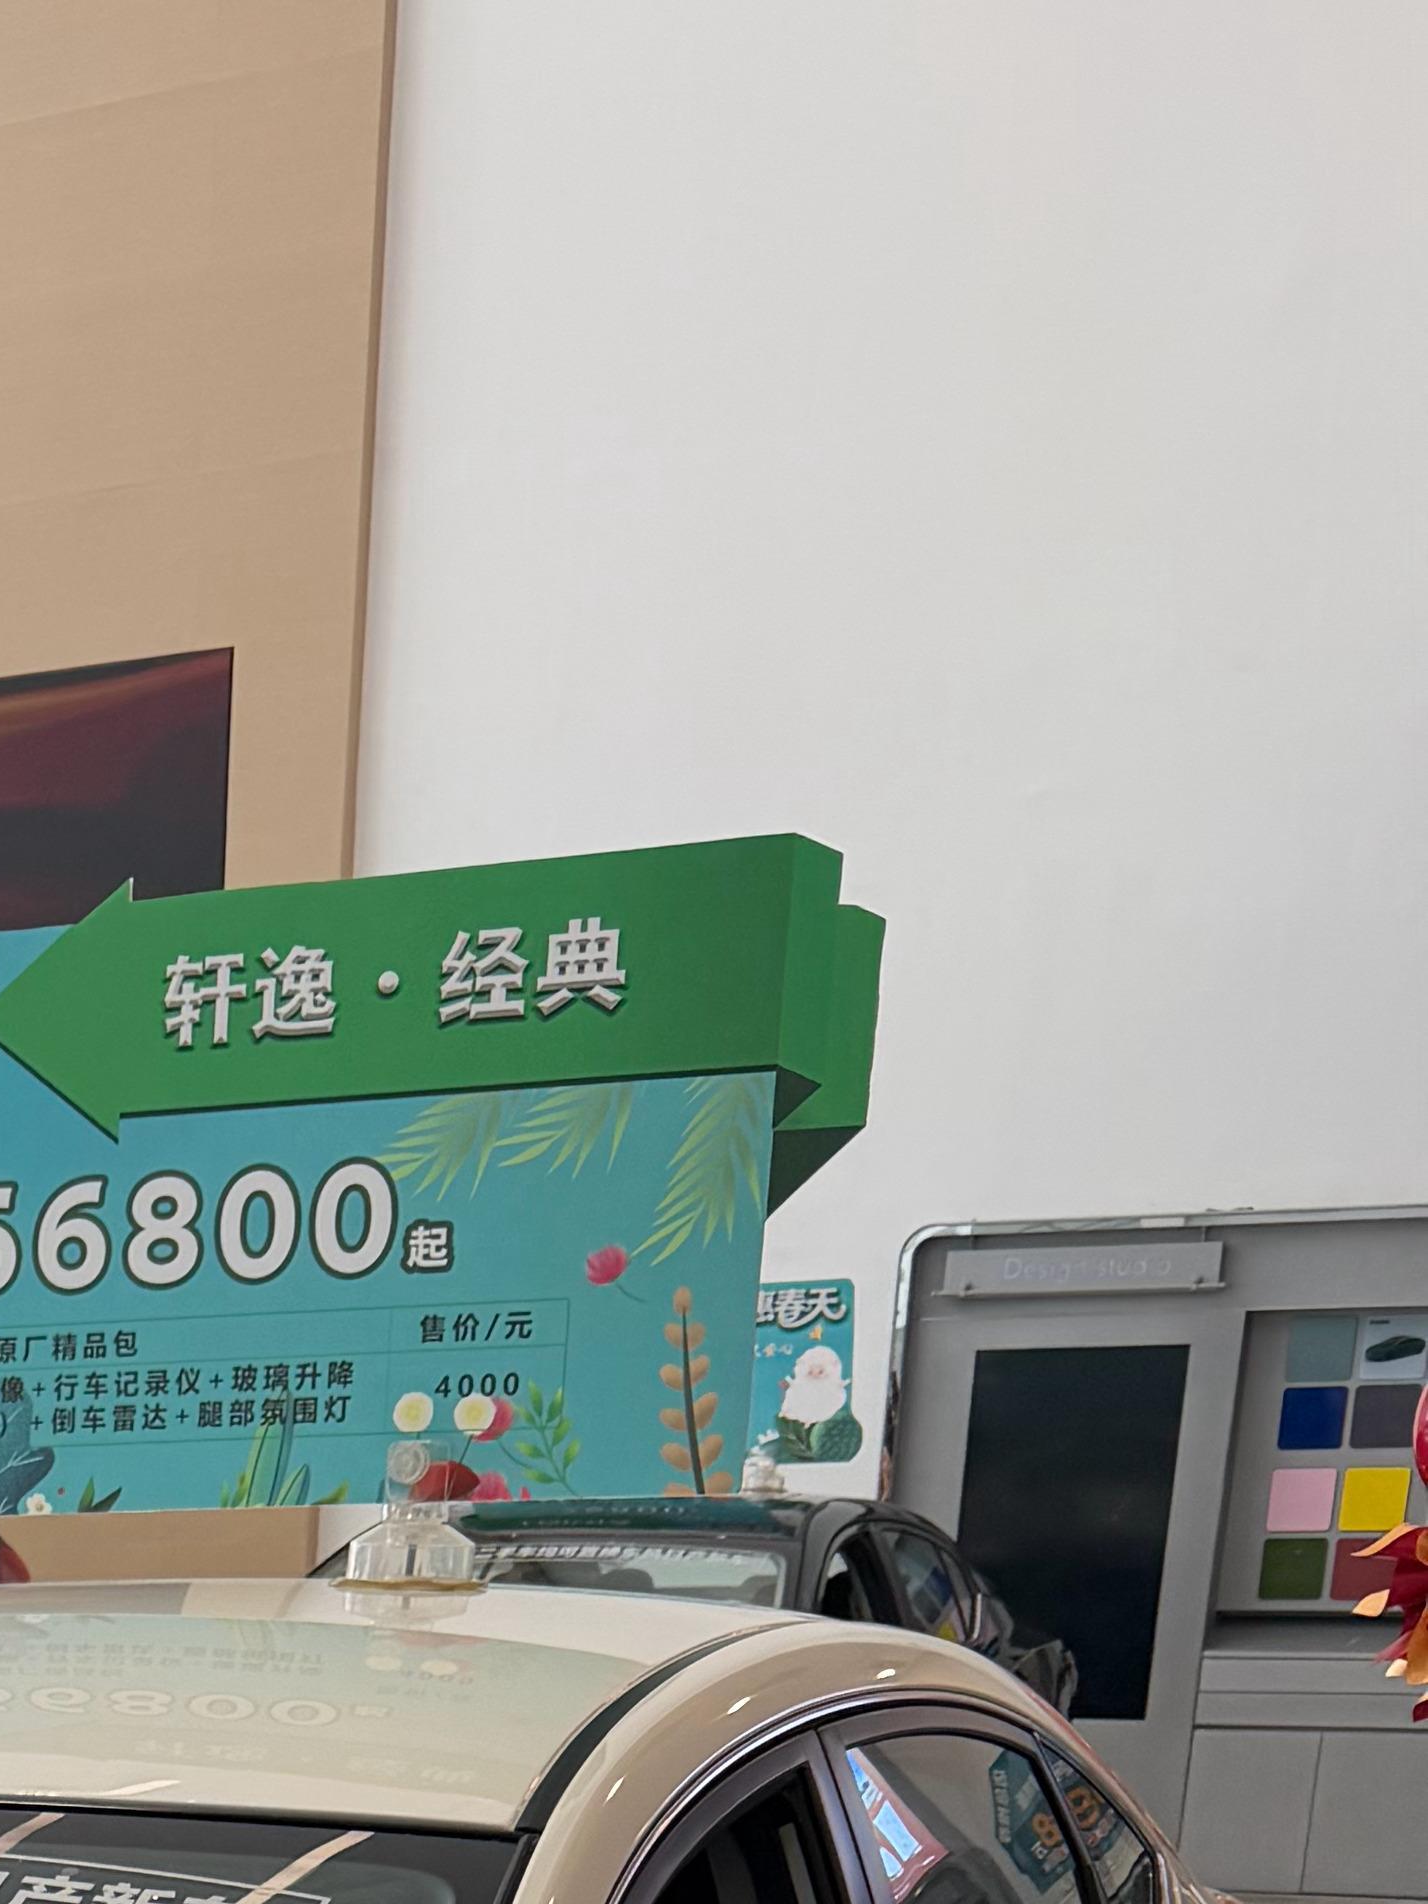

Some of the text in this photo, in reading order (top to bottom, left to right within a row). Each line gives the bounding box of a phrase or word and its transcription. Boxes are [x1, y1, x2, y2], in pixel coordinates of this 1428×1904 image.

[163, 917, 626, 1047] 轩逸·经典
[420, 1310, 534, 1344] 售价/元
[434, 1371, 521, 1400] 4000
